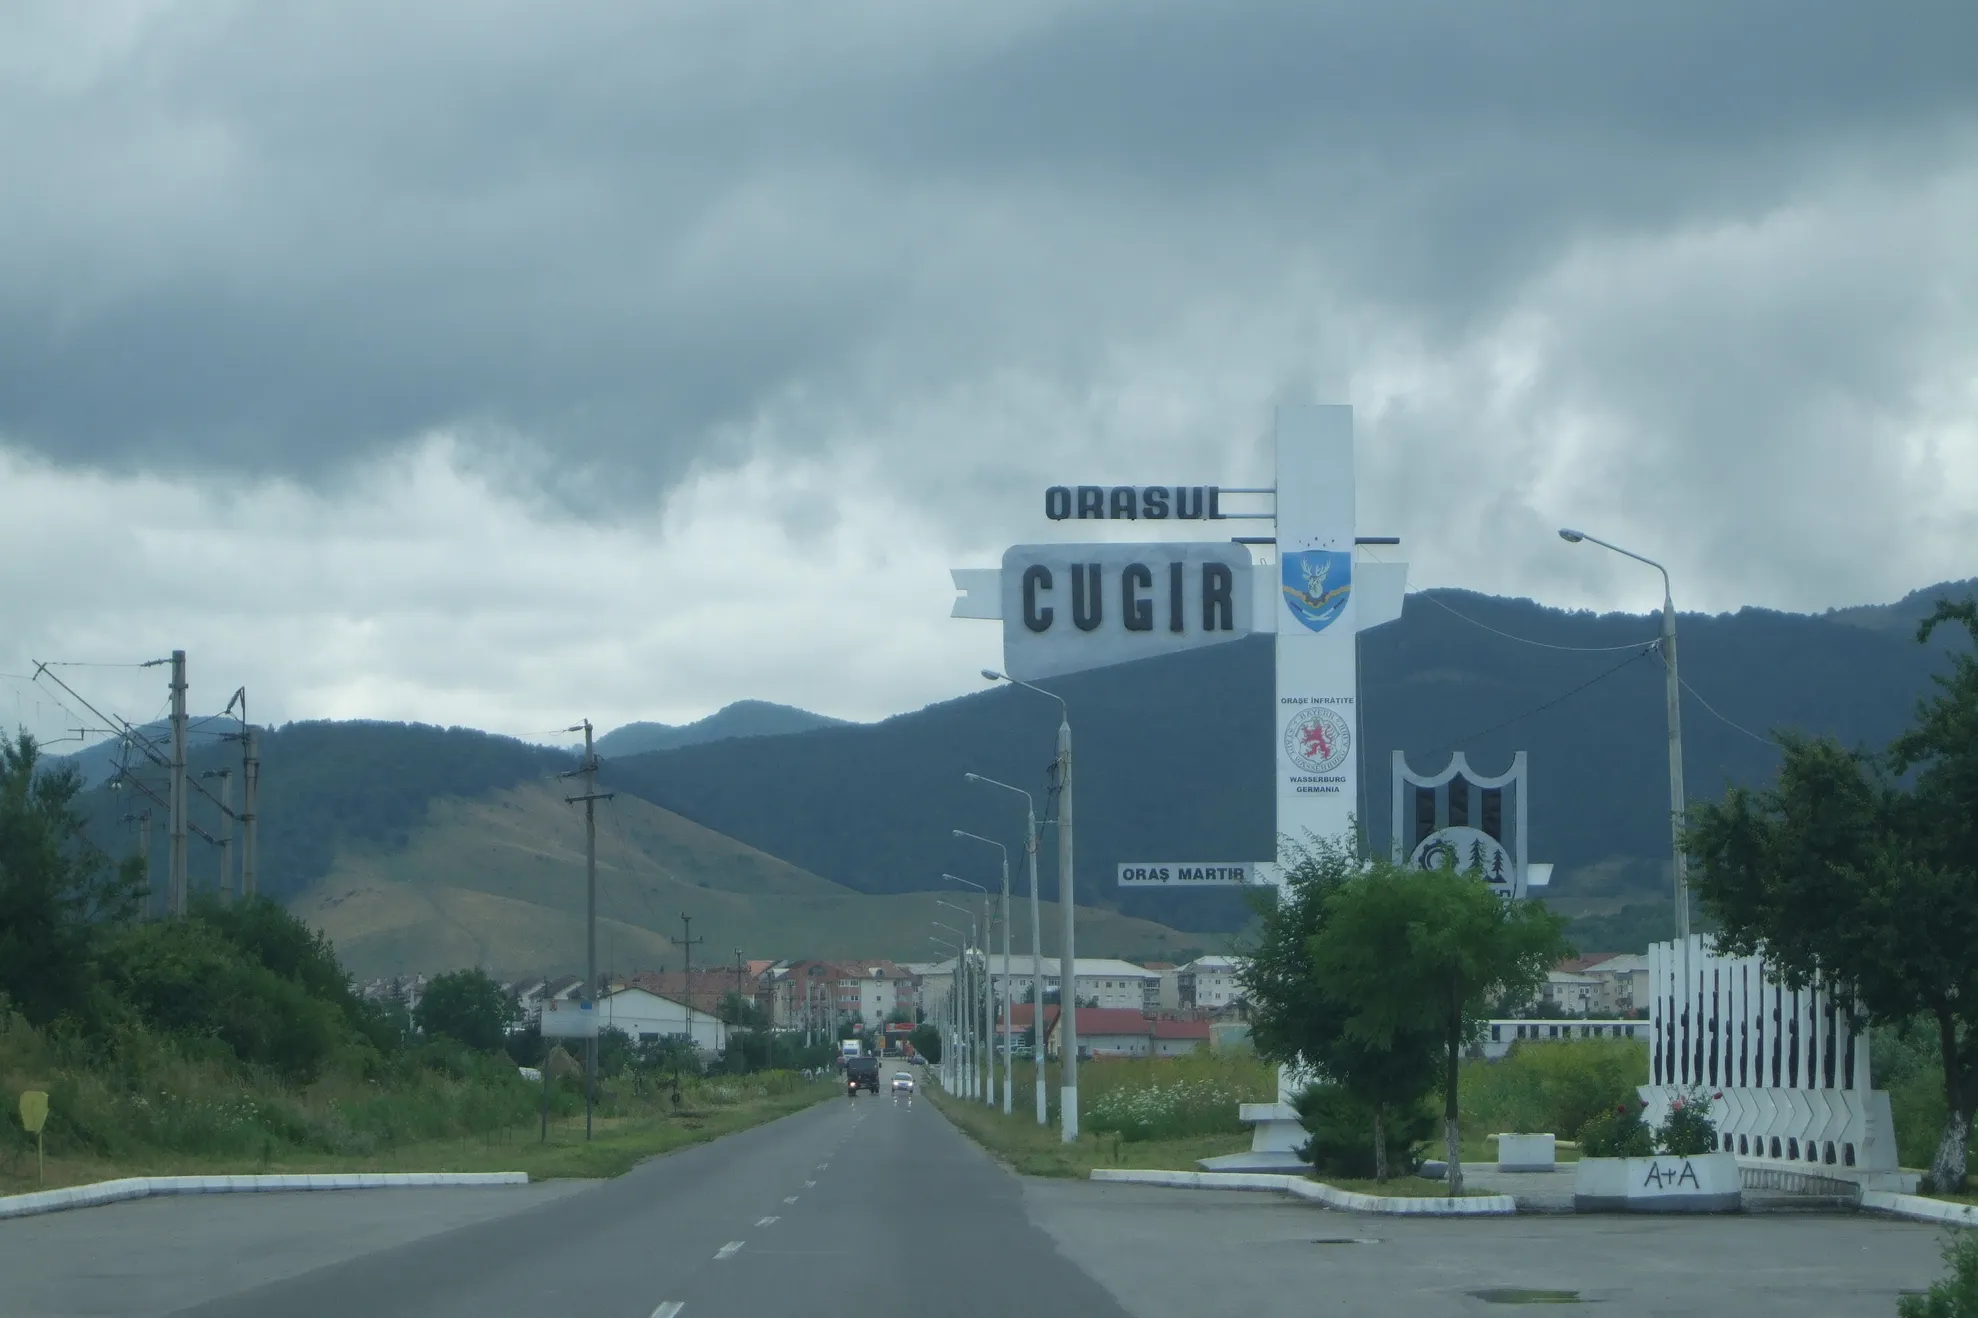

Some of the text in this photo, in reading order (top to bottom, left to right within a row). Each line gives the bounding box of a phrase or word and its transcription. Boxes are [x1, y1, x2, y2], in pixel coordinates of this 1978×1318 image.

[1045, 485, 1227, 520] ORASUL
[1022, 562, 1234, 632] CUGIR
[1178, 868, 1245, 880] MARTIR
[1644, 1161, 1700, 1189] A+A
